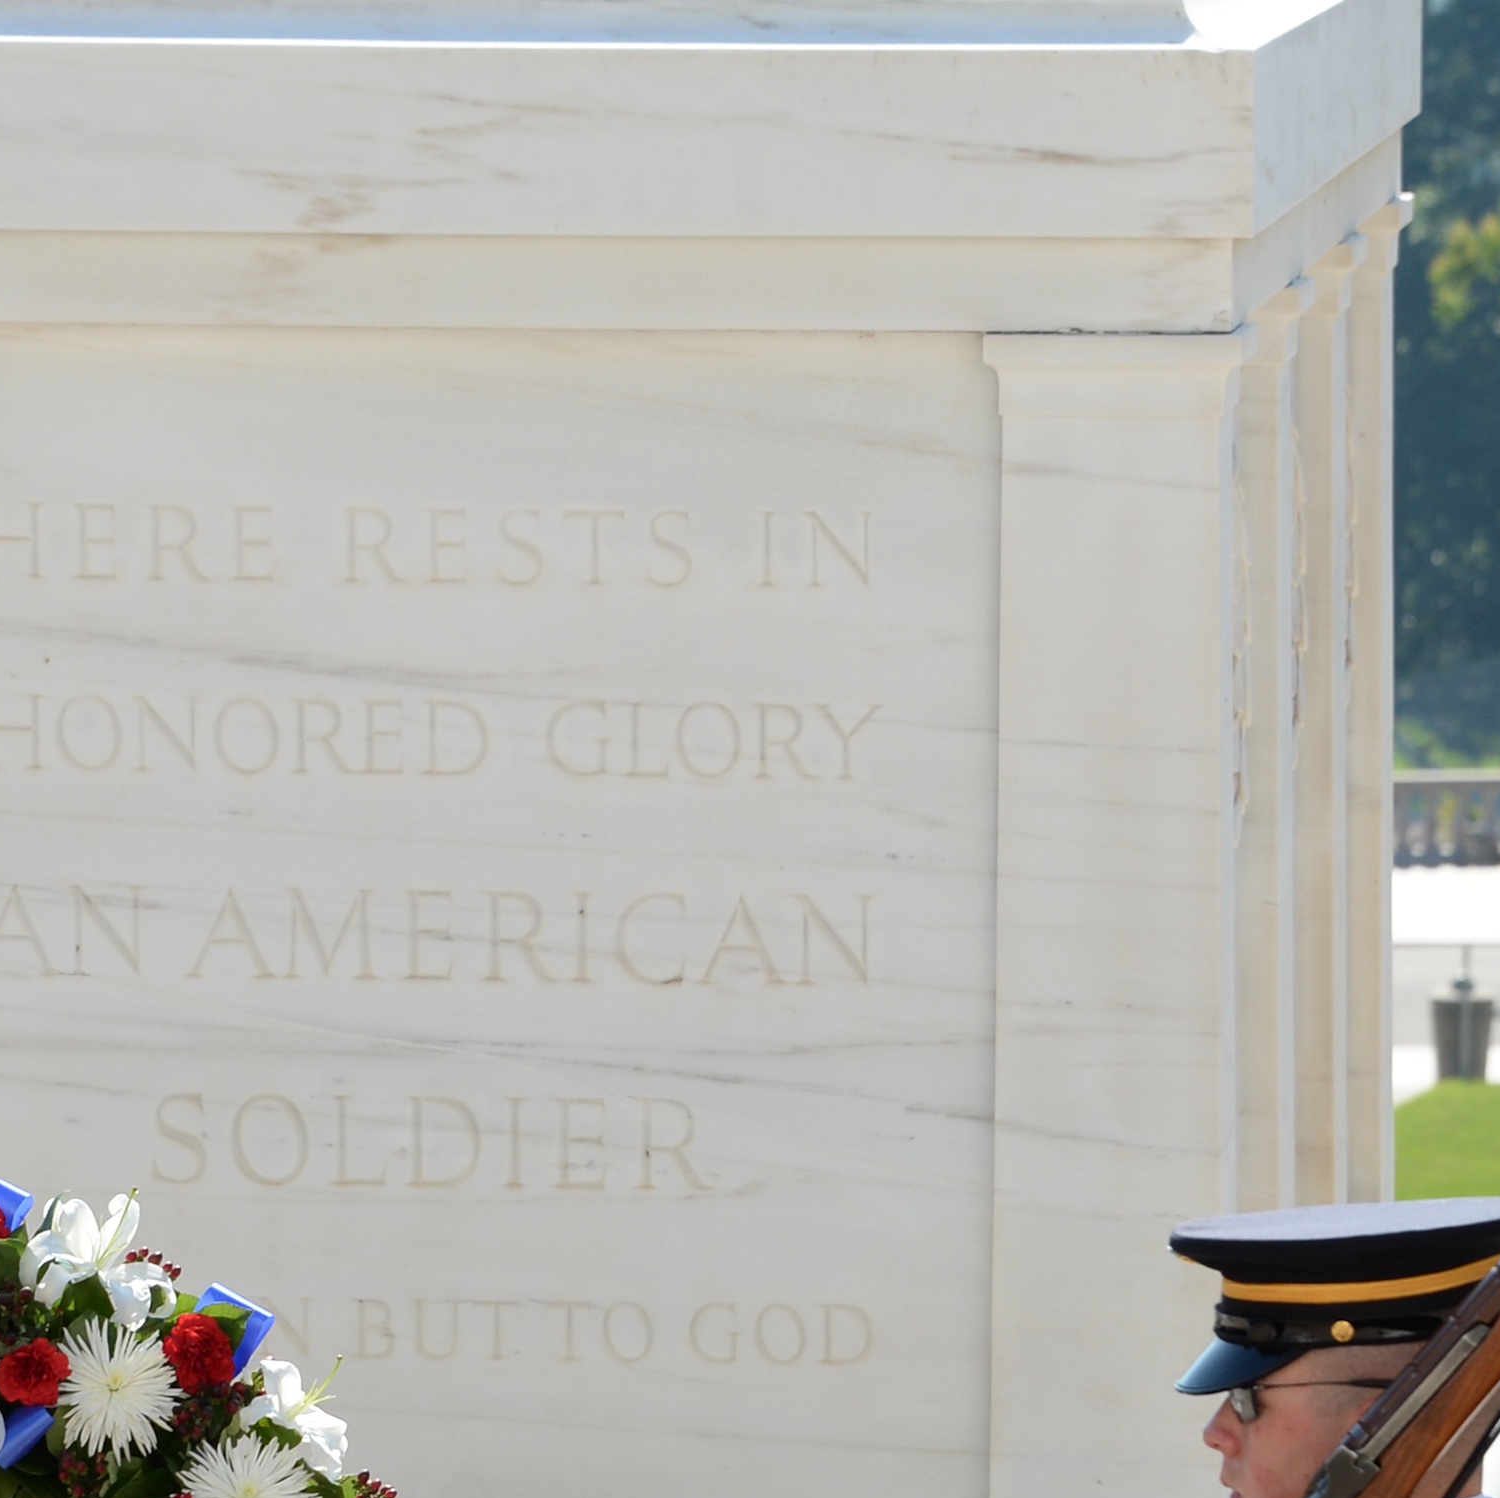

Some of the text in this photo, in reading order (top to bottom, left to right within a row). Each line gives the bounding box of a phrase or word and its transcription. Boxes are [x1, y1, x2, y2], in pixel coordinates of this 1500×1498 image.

[342, 506, 694, 588] RESTS
[754, 509, 874, 589] IN
[546, 699, 882, 781] GLORY
[186, 886, 874, 986] AMERICAN
[151, 1092, 713, 1191] SOLDIER
[353, 1299, 519, 1360] BUT
[546, 1301, 654, 1363] TO
[687, 1302, 875, 1366] GOD
